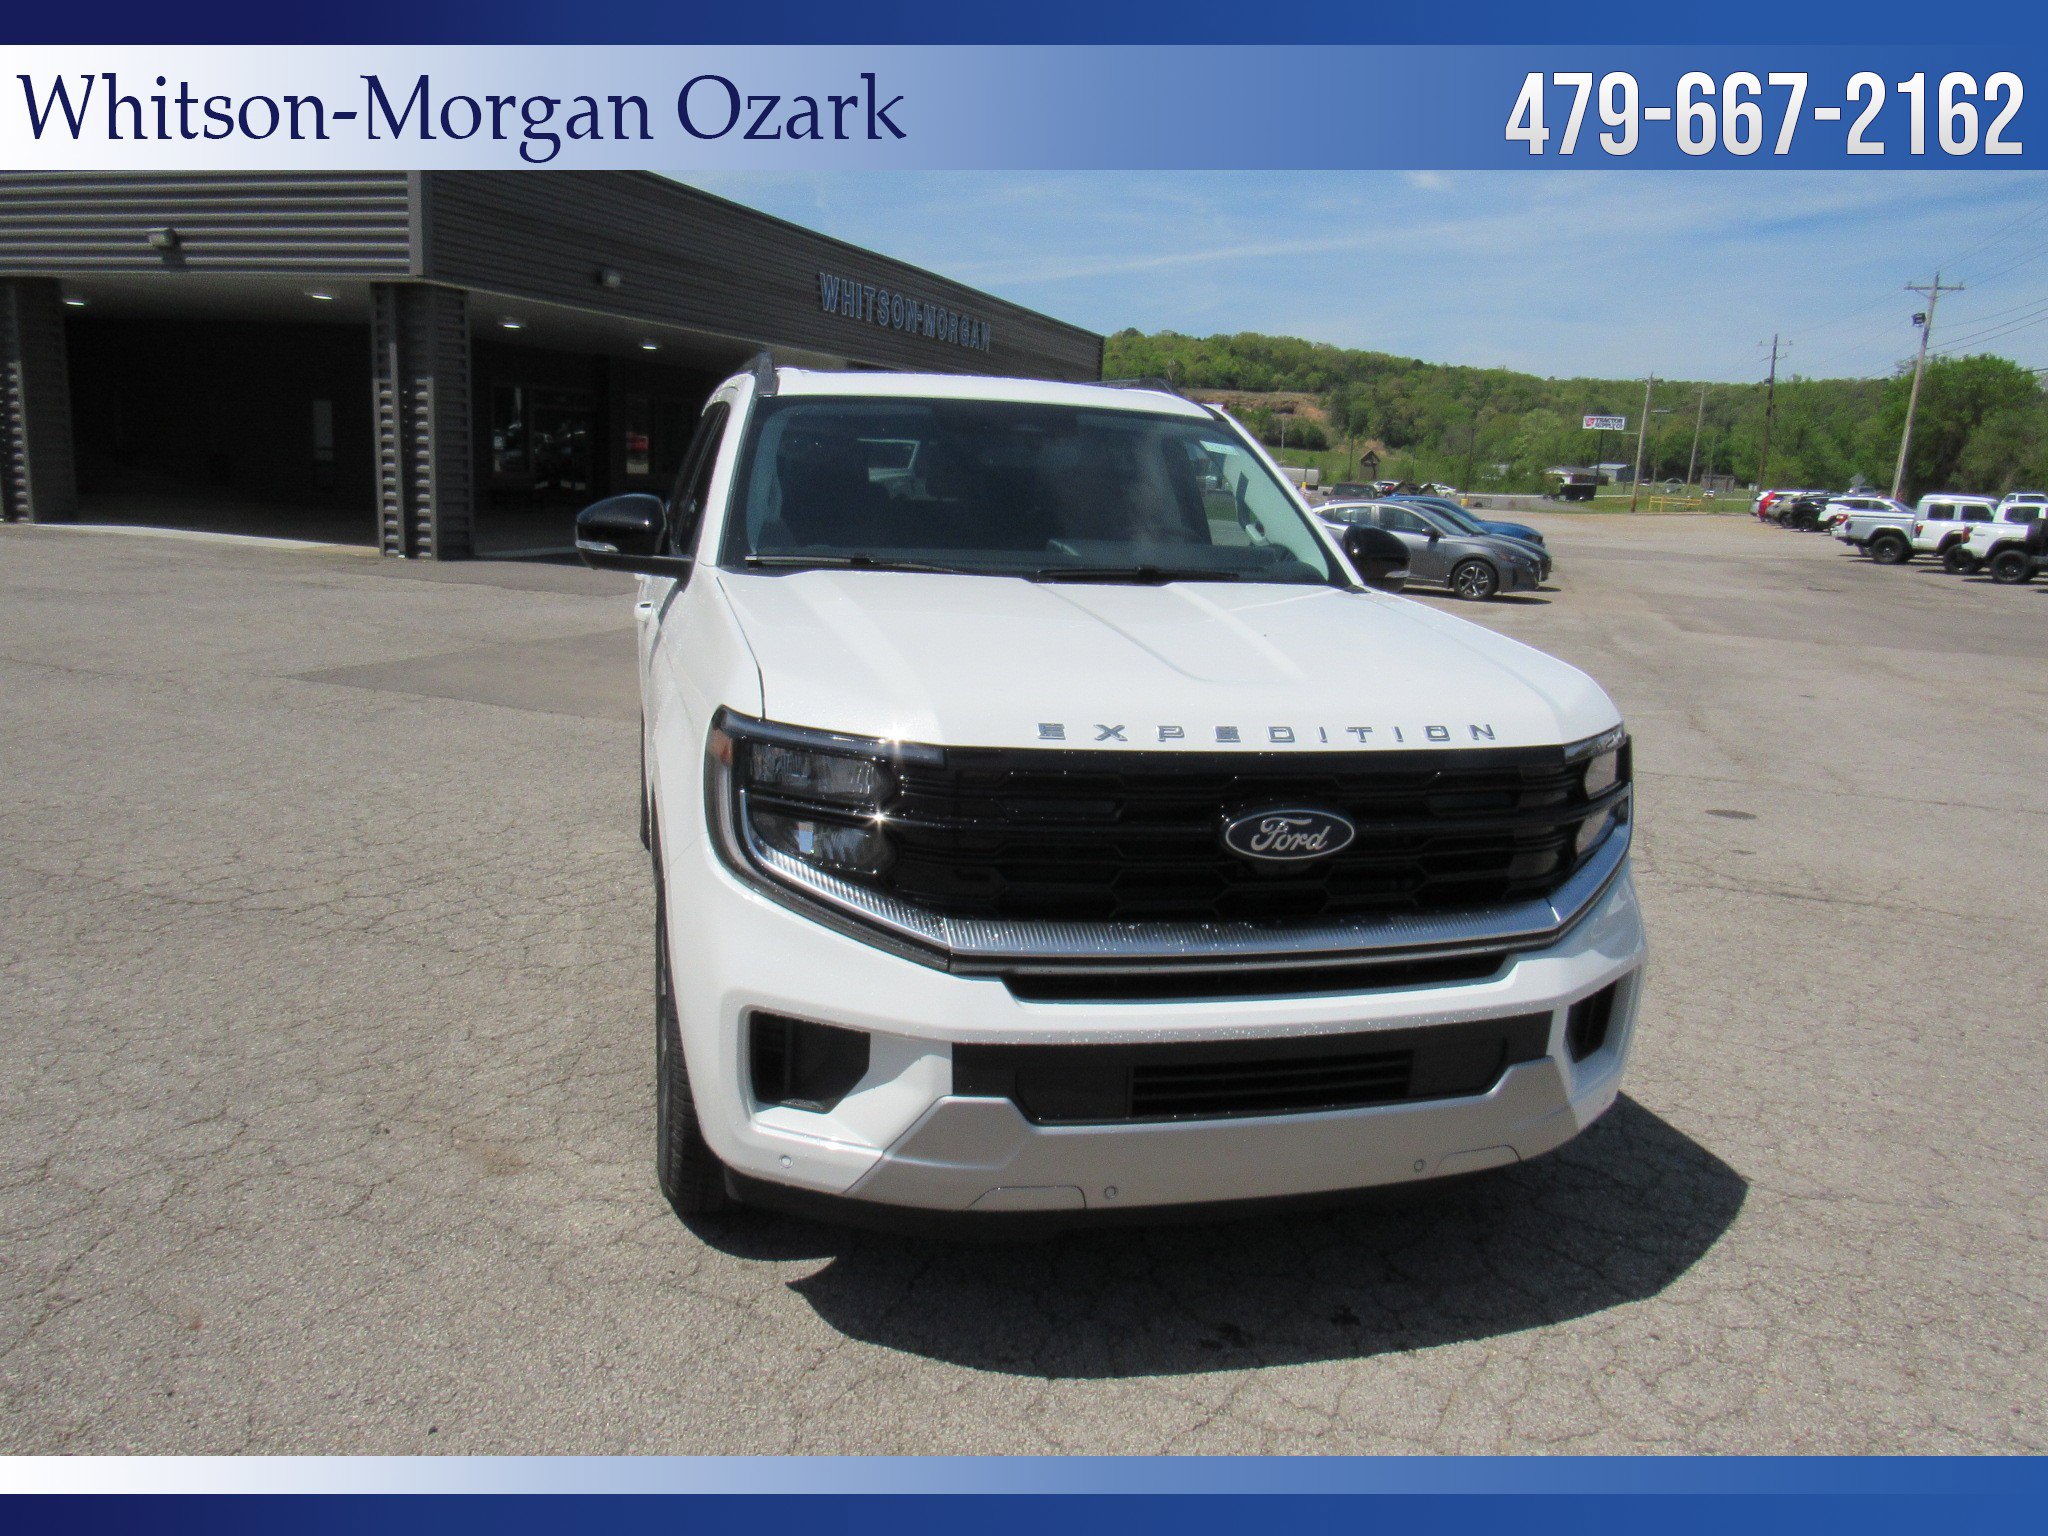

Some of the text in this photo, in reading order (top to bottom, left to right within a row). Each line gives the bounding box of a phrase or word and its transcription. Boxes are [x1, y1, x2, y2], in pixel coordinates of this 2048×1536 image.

[820, 272, 990, 352] WHITSON-MORGAN
[1037, 723, 1497, 742] EXPEDITION
[1250, 817, 1332, 852] Ford
